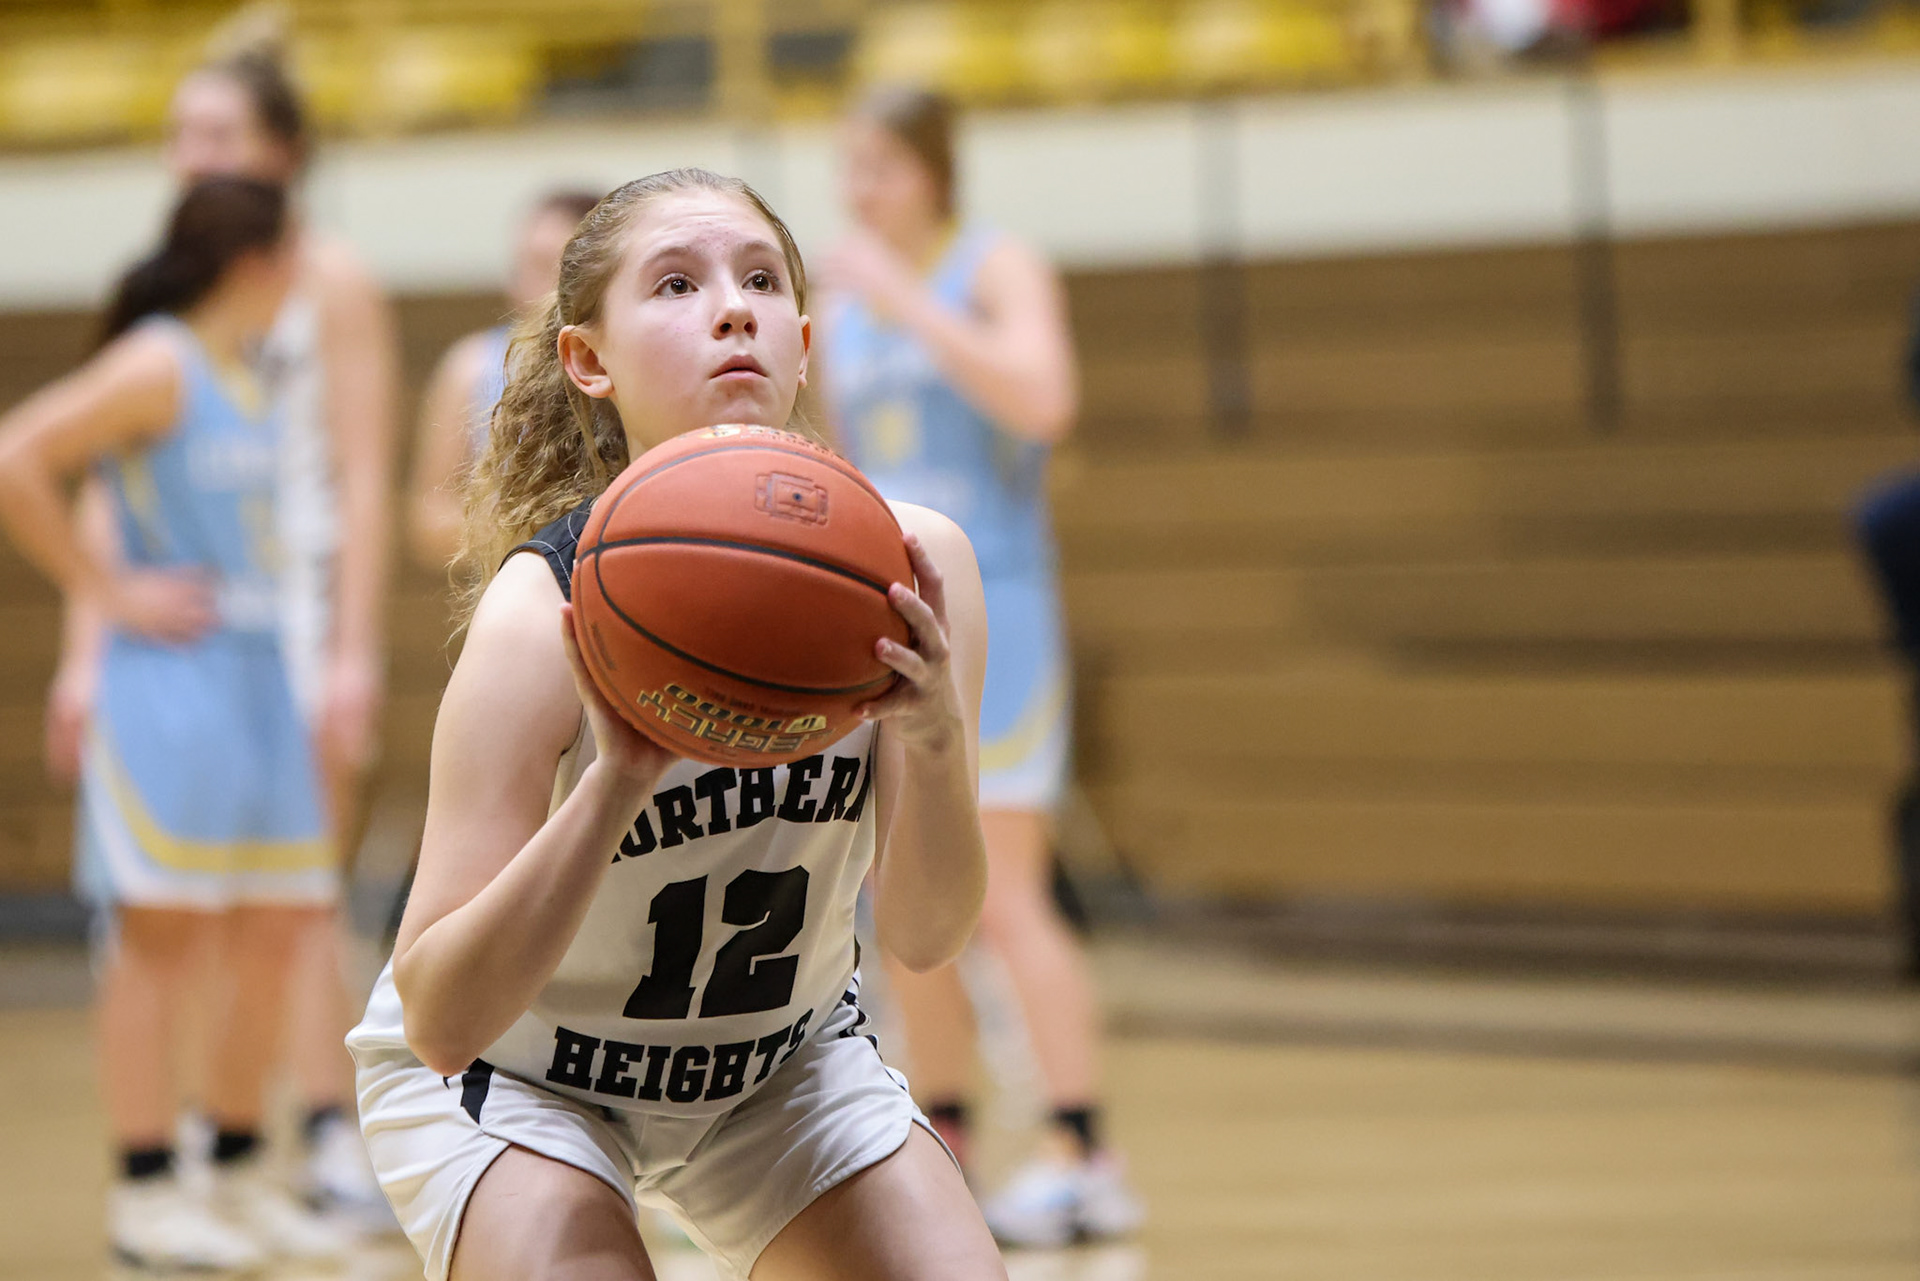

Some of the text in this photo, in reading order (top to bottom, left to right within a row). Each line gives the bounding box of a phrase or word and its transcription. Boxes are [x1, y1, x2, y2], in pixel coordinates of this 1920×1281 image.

[610, 753, 872, 865] ORTHER
[622, 865, 810, 1021] 12
[546, 1008, 814, 1104] HEIGHTS
